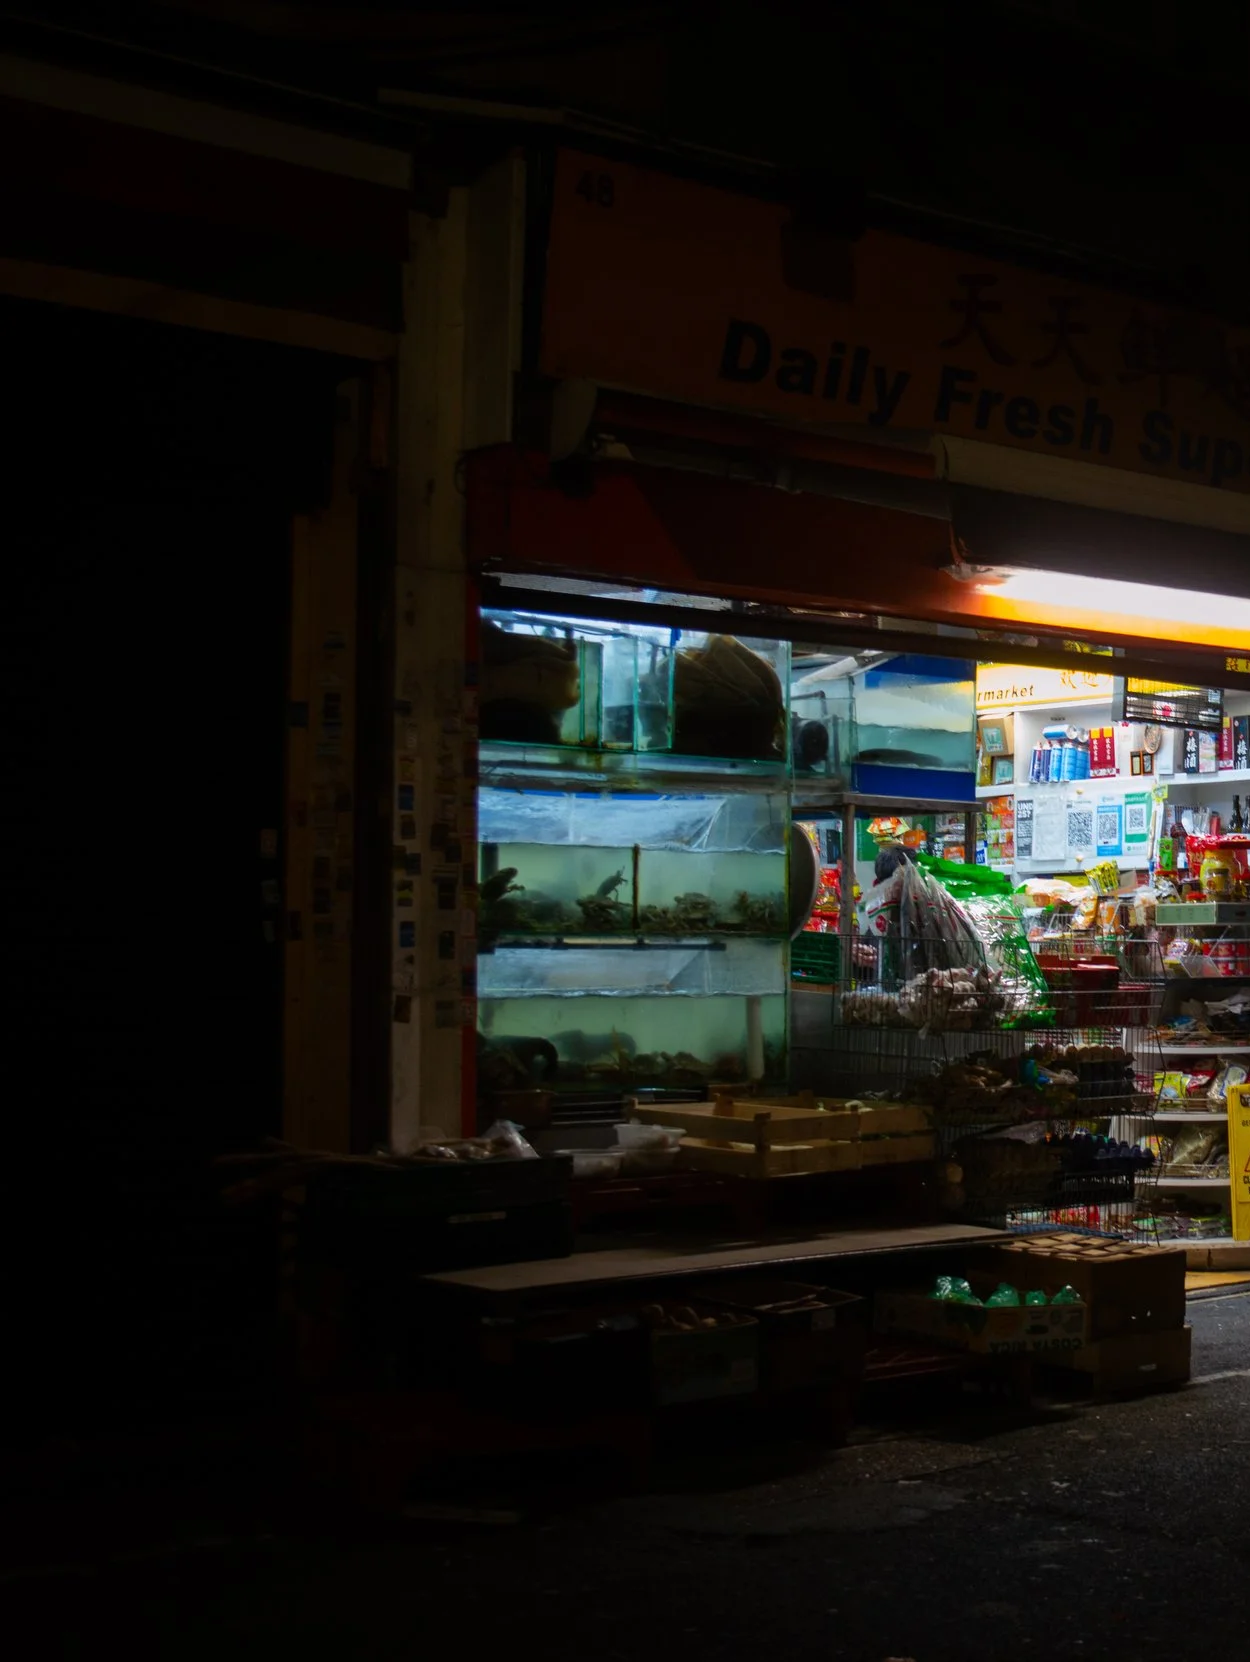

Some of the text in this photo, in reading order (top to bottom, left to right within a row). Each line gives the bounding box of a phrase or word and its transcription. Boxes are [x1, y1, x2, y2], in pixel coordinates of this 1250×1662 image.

[574, 169, 616, 208] 48
[718, 319, 911, 427] Daily
[933, 365, 1114, 456] Fresh
[988, 1337, 1083, 1355] COSTA RICA
